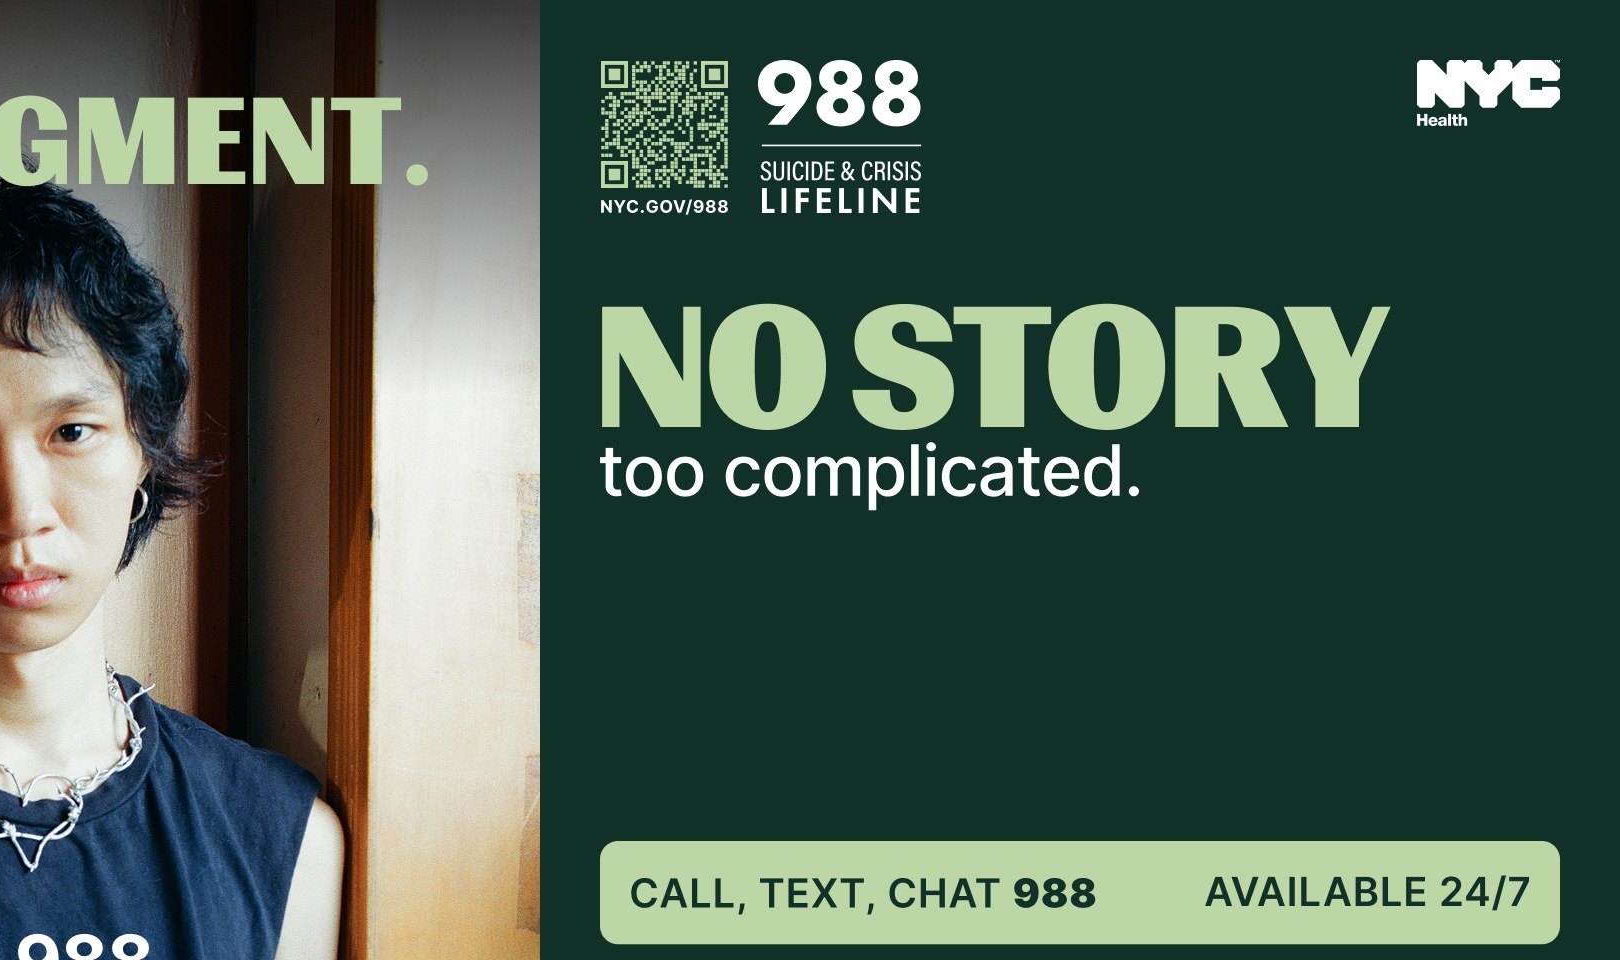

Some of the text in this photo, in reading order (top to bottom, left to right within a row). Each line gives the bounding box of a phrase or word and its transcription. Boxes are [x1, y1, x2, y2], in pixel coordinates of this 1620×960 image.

[758, 60, 921, 127] 988
[1417, 60, 1560, 108] NYC
[1417, 114, 1468, 126] Health
[760, 161, 921, 181] SUICIDE & CRISIS
[600, 199, 728, 215] NYC.GOV/988
[762, 188, 920, 213] LIFELINE
[602, 304, 1390, 430] NO STORY
[600, 442, 1139, 511] too complicated.
[630, 877, 1095, 915] CALL, TEXT, CHAT 988
[1205, 875, 1529, 911] AVAILABLE 24/7
